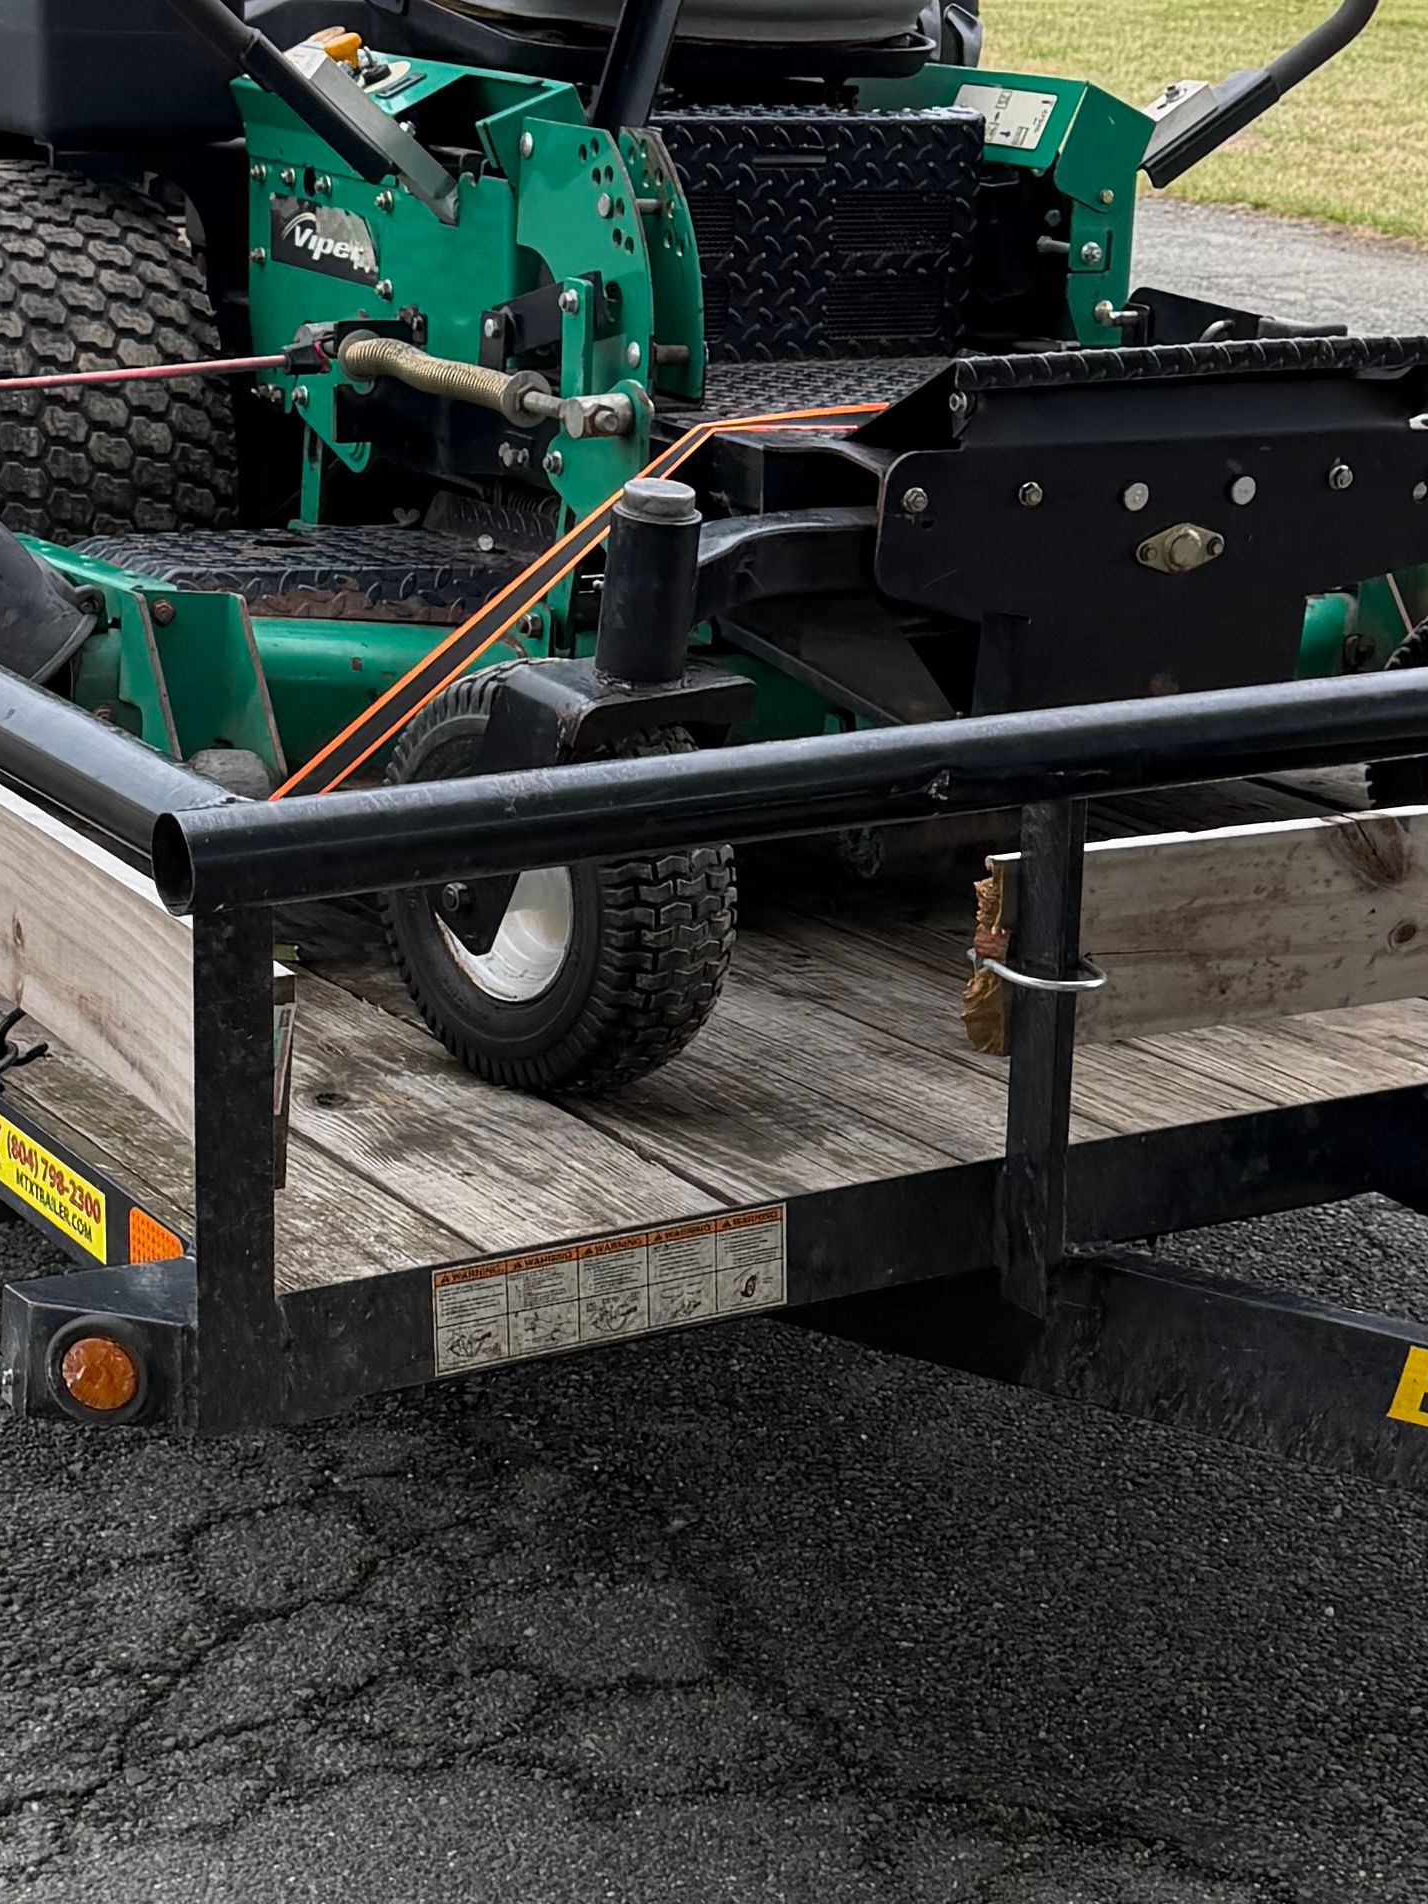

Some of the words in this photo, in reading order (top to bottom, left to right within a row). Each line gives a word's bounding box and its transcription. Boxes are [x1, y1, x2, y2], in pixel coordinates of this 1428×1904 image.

[294, 225, 364, 261] Viper
[6, 1130, 39, 1179] (804)
[40, 1158, 102, 1225] 798-2300
[452, 1264, 504, 1280] WARNING
